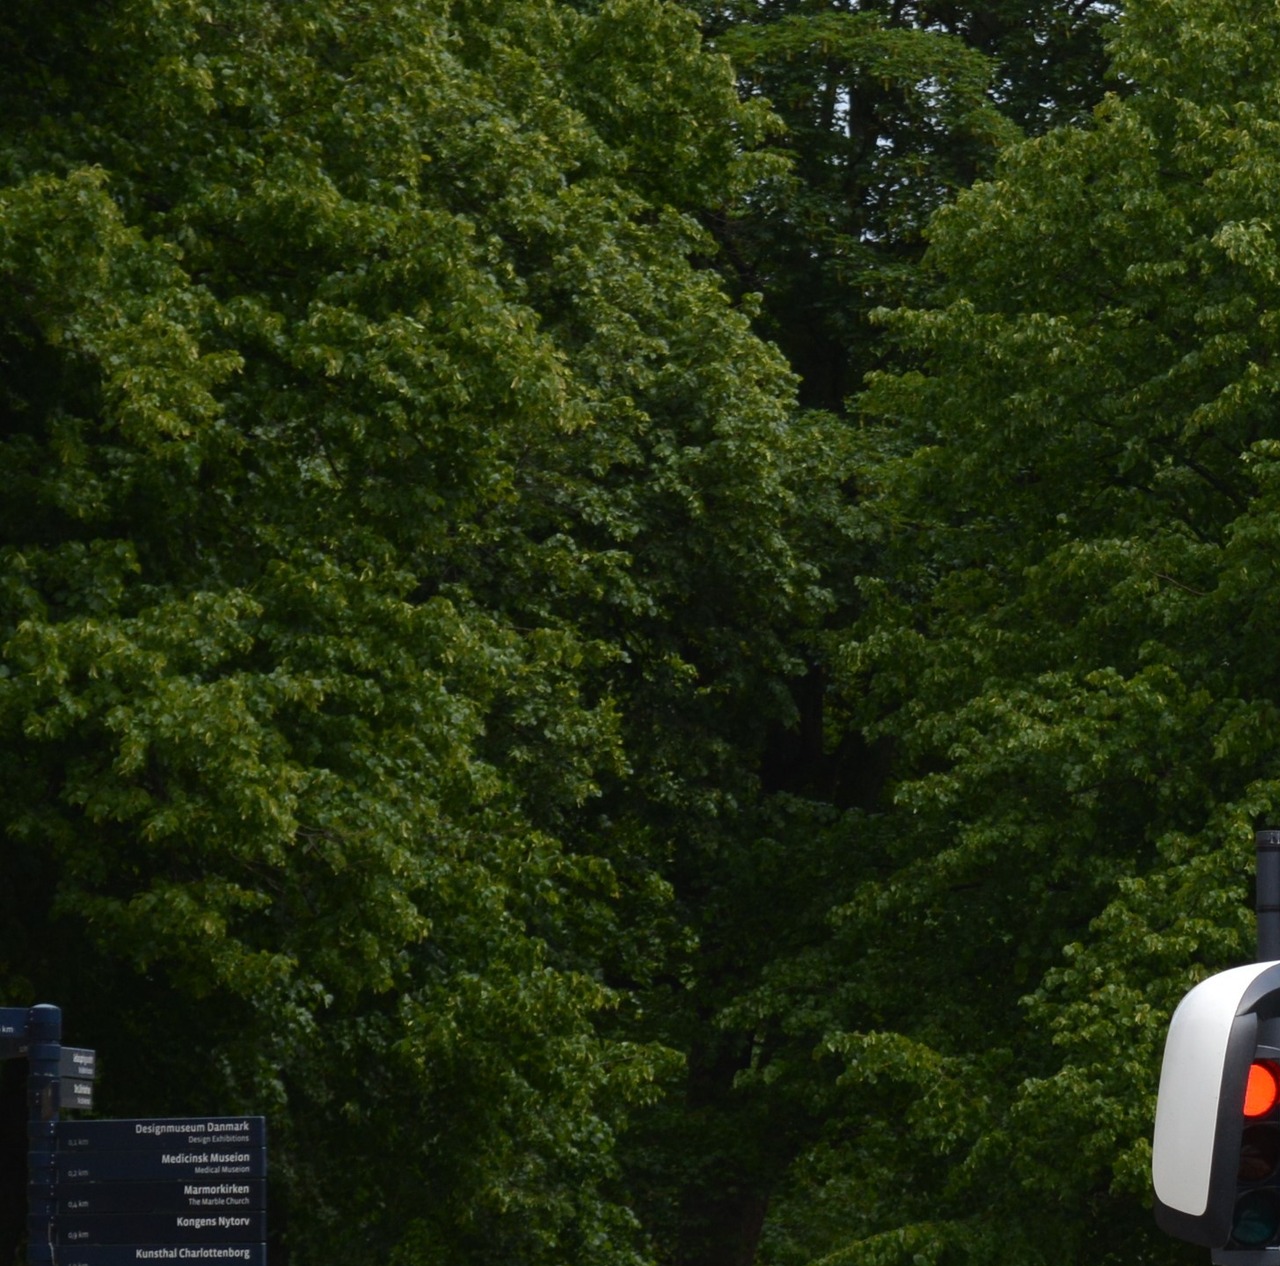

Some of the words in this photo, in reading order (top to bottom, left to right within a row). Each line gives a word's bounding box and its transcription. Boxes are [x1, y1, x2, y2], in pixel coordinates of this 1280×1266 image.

[135, 1123, 206, 1135] Designmuseum
[207, 1121, 249, 1132] Danmark
[188, 1135, 211, 1144] Design
[212, 1134, 249, 1143] Exhibitions
[161, 1153, 208, 1164] Medicinsk
[209, 1152, 250, 1163] Museion
[194, 1166, 221, 1174] Medical
[222, 1165, 250, 1173] Museion
[184, 1184, 249, 1195] Marmorkirken
[226, 1197, 249, 1205] Church
[176, 1216, 217, 1228] Kongens
[218, 1216, 250, 1228] Nytorv
[135, 1248, 177, 1259] Kunsthal
[179, 1247, 250, 1260] Charlottenborg
